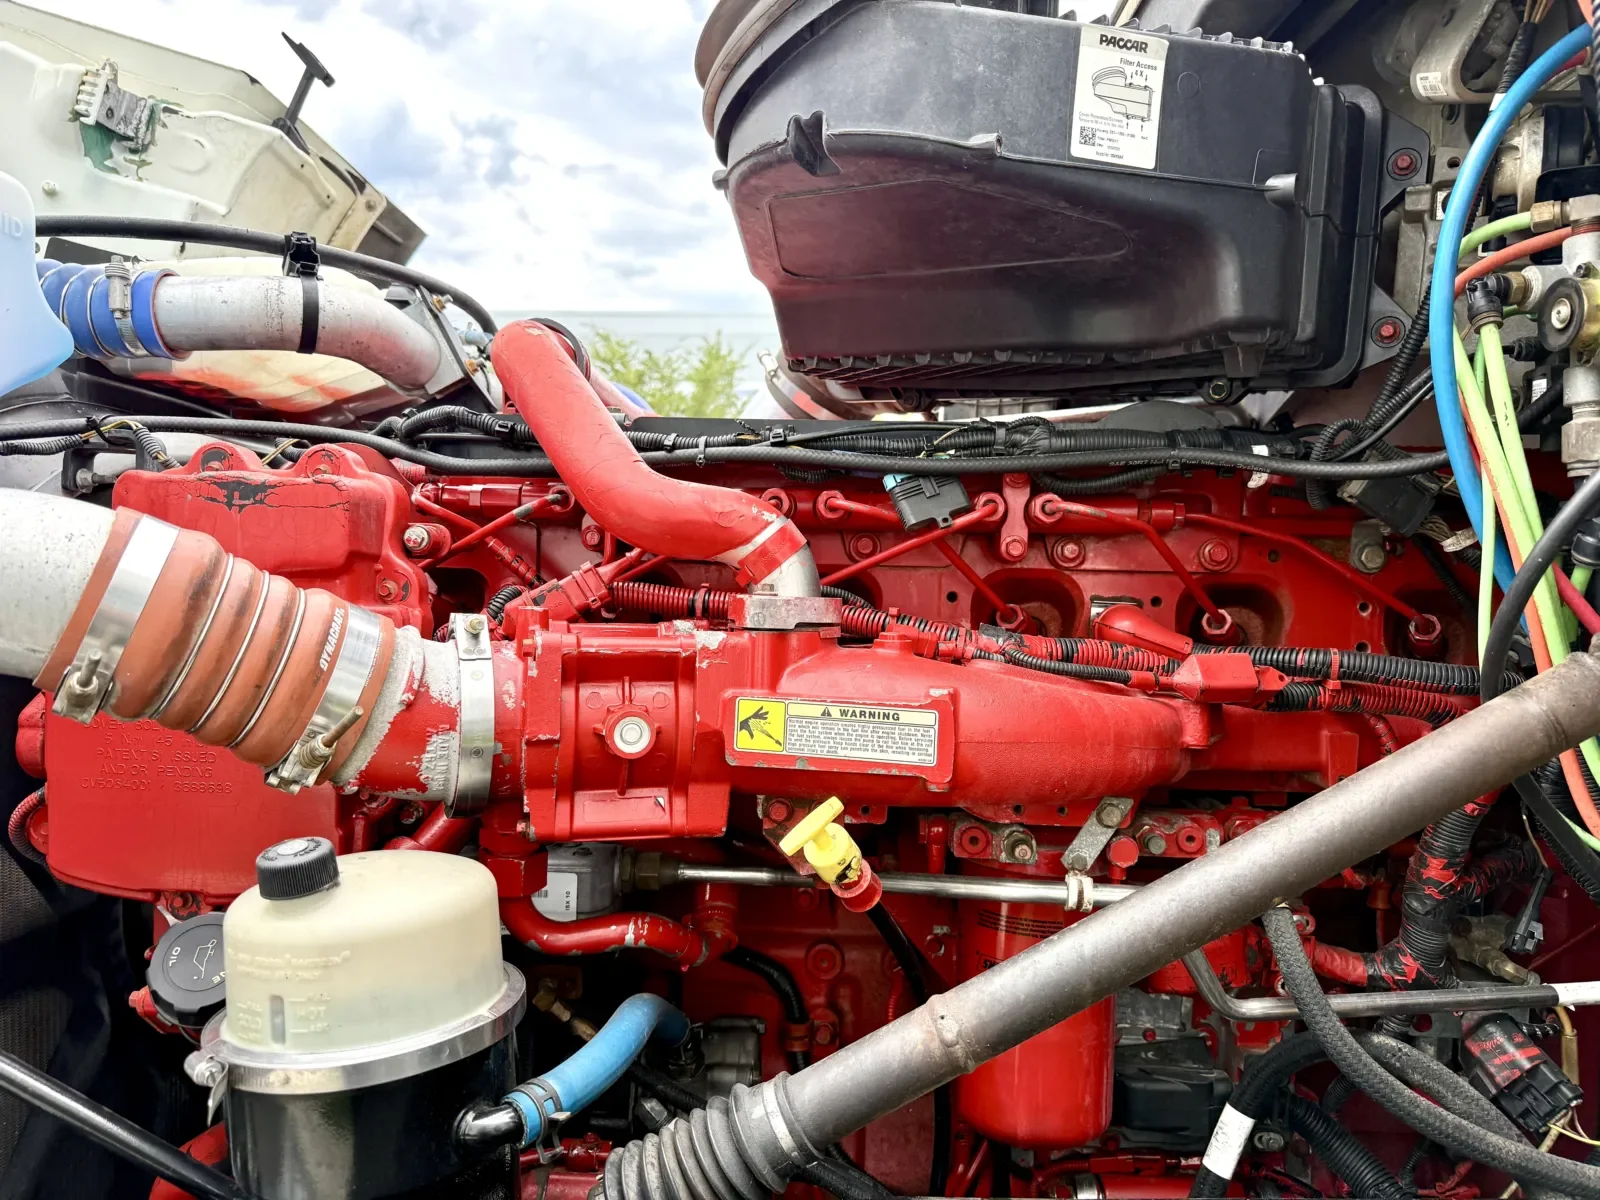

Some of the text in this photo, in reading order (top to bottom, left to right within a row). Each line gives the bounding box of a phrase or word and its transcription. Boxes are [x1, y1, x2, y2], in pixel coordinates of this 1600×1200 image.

[1099, 34, 1148, 53] PACCAR
[1120, 58, 1157, 70] Filter Access
[320, 606, 346, 673] DYNACRAFT
[840, 708, 900, 722] WARNING
[136, 719, 163, 731] BOL
[172, 750, 217, 764] ISSUED
[157, 765, 213, 778] PENDING
[169, 946, 181, 967] OIL
[297, 1006, 326, 1020] HOT
